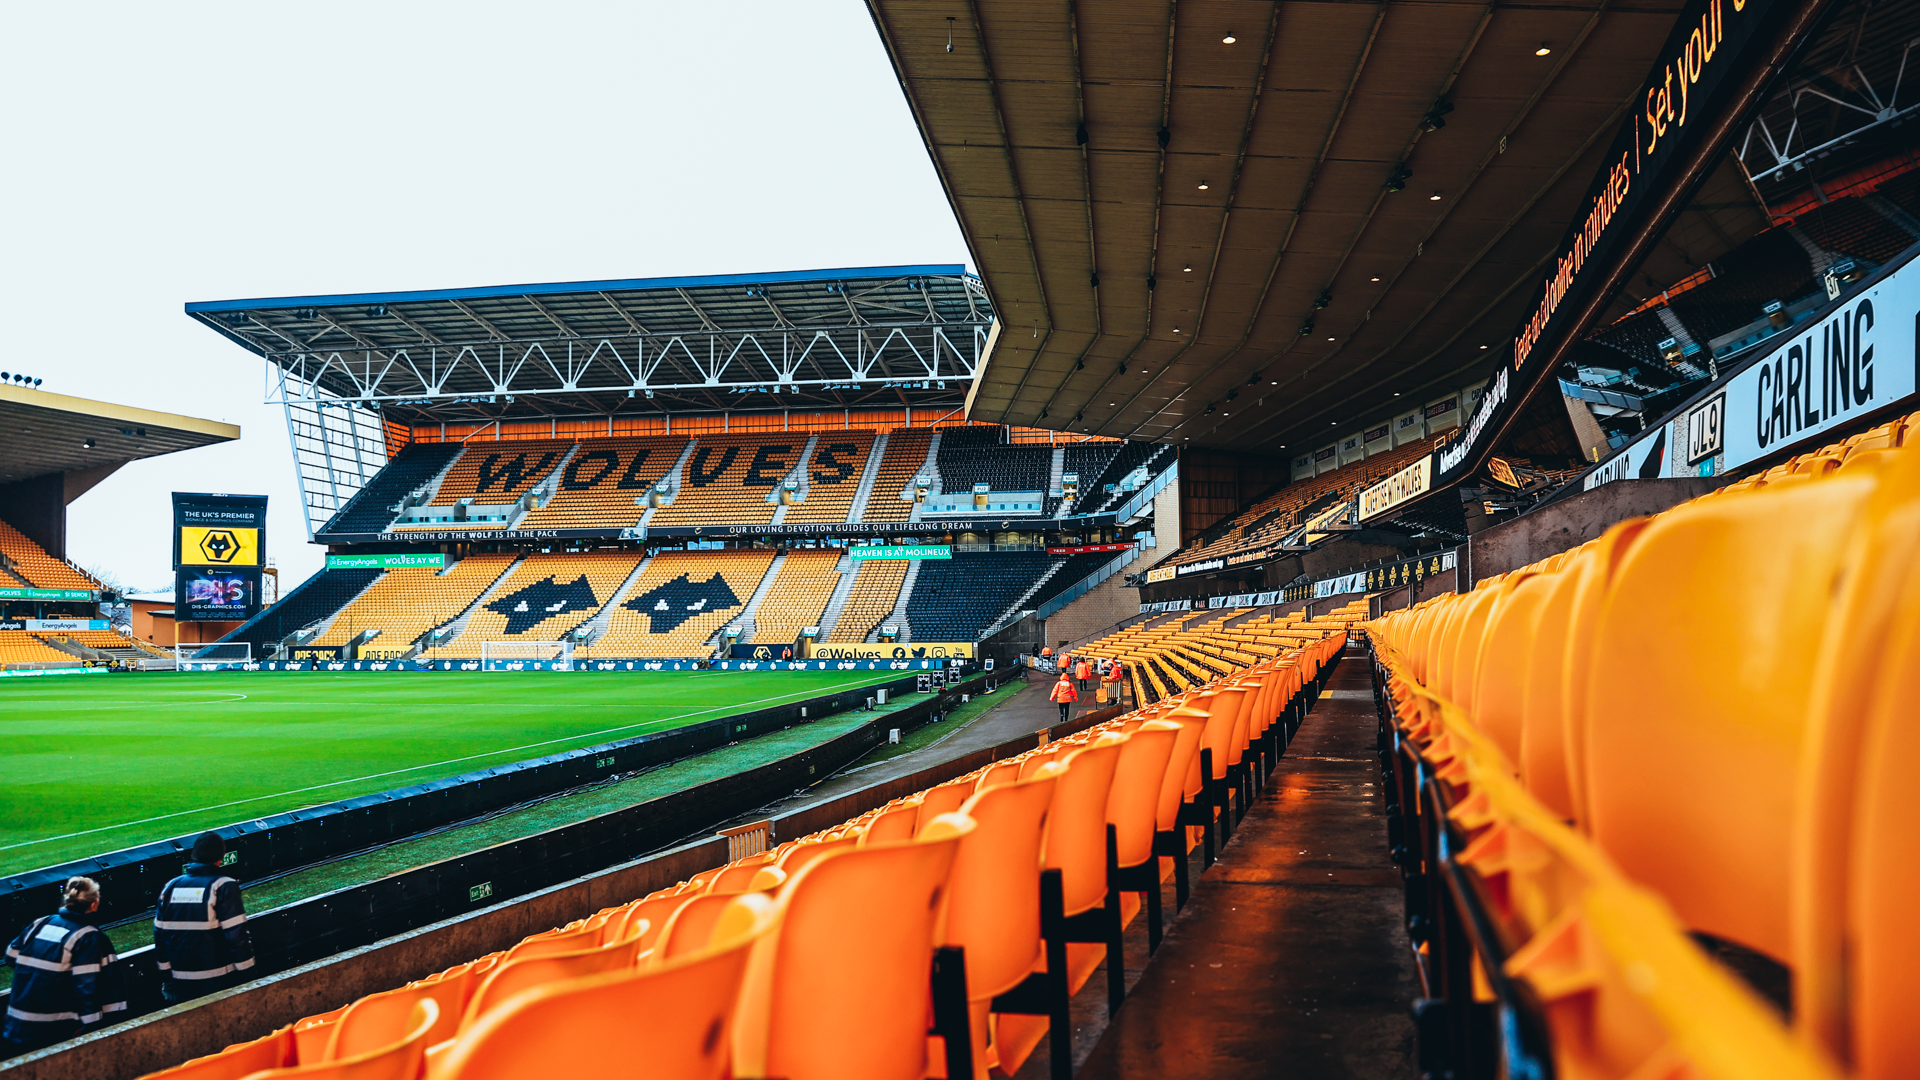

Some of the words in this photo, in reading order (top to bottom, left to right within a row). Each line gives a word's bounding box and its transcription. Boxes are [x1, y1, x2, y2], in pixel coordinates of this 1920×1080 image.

[1540, 279, 1550, 330] ad
[1550, 250, 1574, 314] online
[1574, 232, 1584, 274] in
[1584, 150, 1630, 258] minutes
[1646, 64, 1675, 155] Set
[1756, 298, 1874, 449] CARLING
[1694, 404, 1717, 456] JL9
[476, 443, 858, 493] WOLVES
[787, 525, 832, 533] DEVOTION
[836, 524, 869, 532] GUIDES
[906, 548, 950, 556] MOLINEUX
[816, 647, 881, 658] @Wolves
